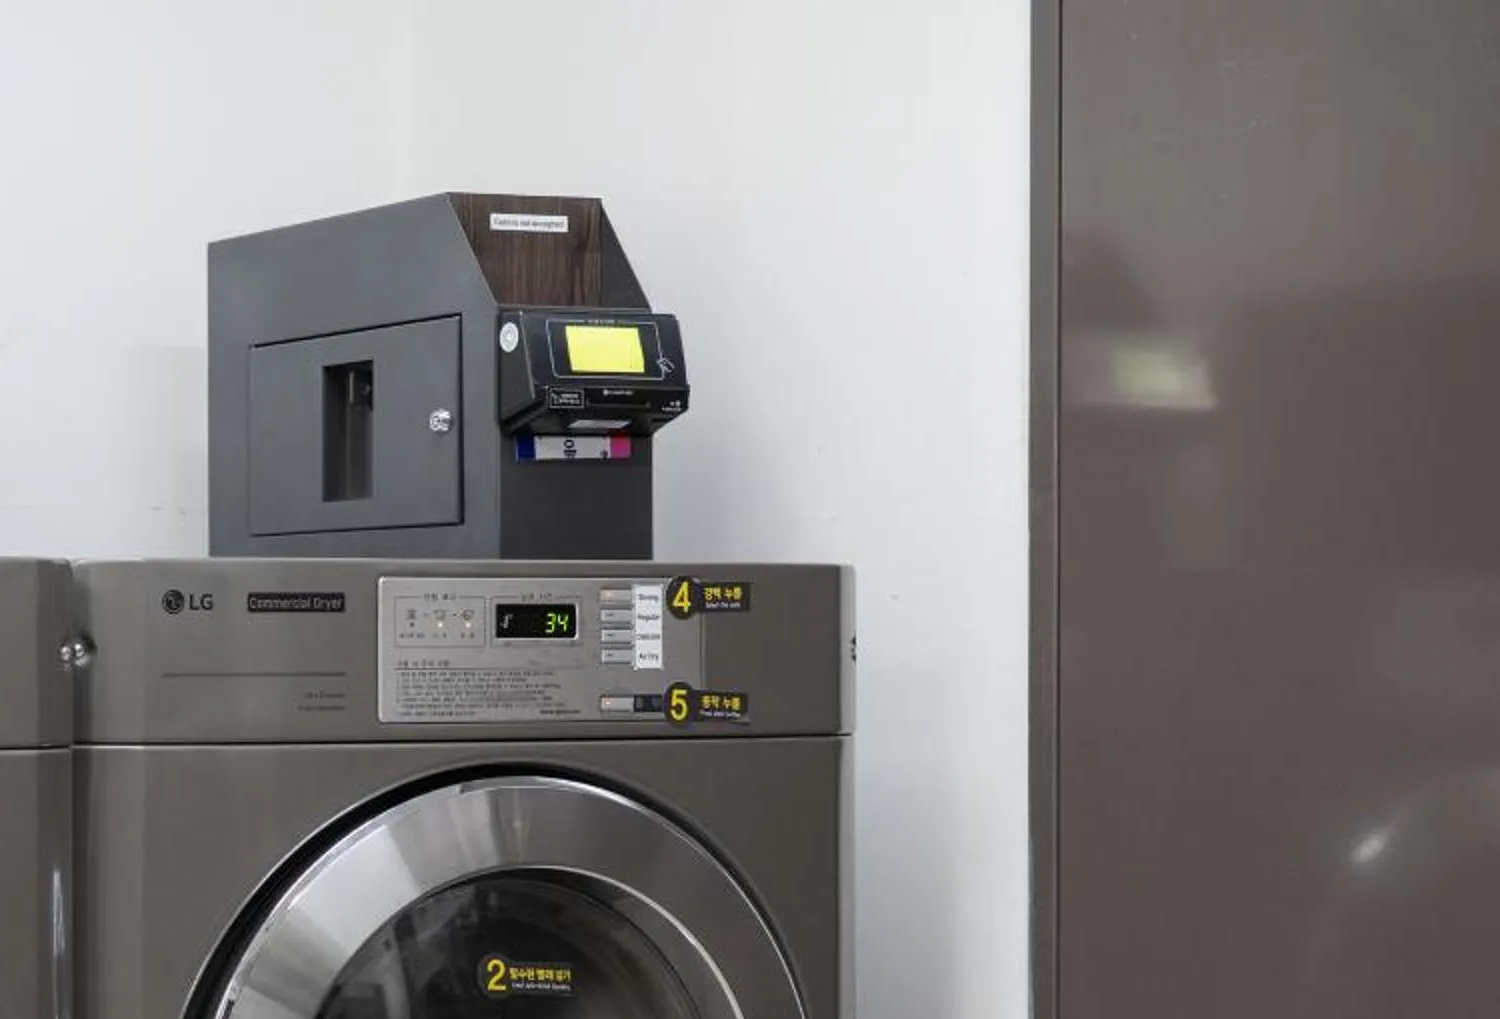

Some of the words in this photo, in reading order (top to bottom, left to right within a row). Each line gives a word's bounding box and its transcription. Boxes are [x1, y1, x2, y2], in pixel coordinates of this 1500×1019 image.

[189, 593, 213, 611] LG
[250, 596, 311, 610] Commercial
[313, 596, 342, 611] Dryer
[672, 581, 692, 613] 4
[543, 612, 569, 634] 34
[670, 689, 689, 721] 5
[487, 959, 507, 991] 2
